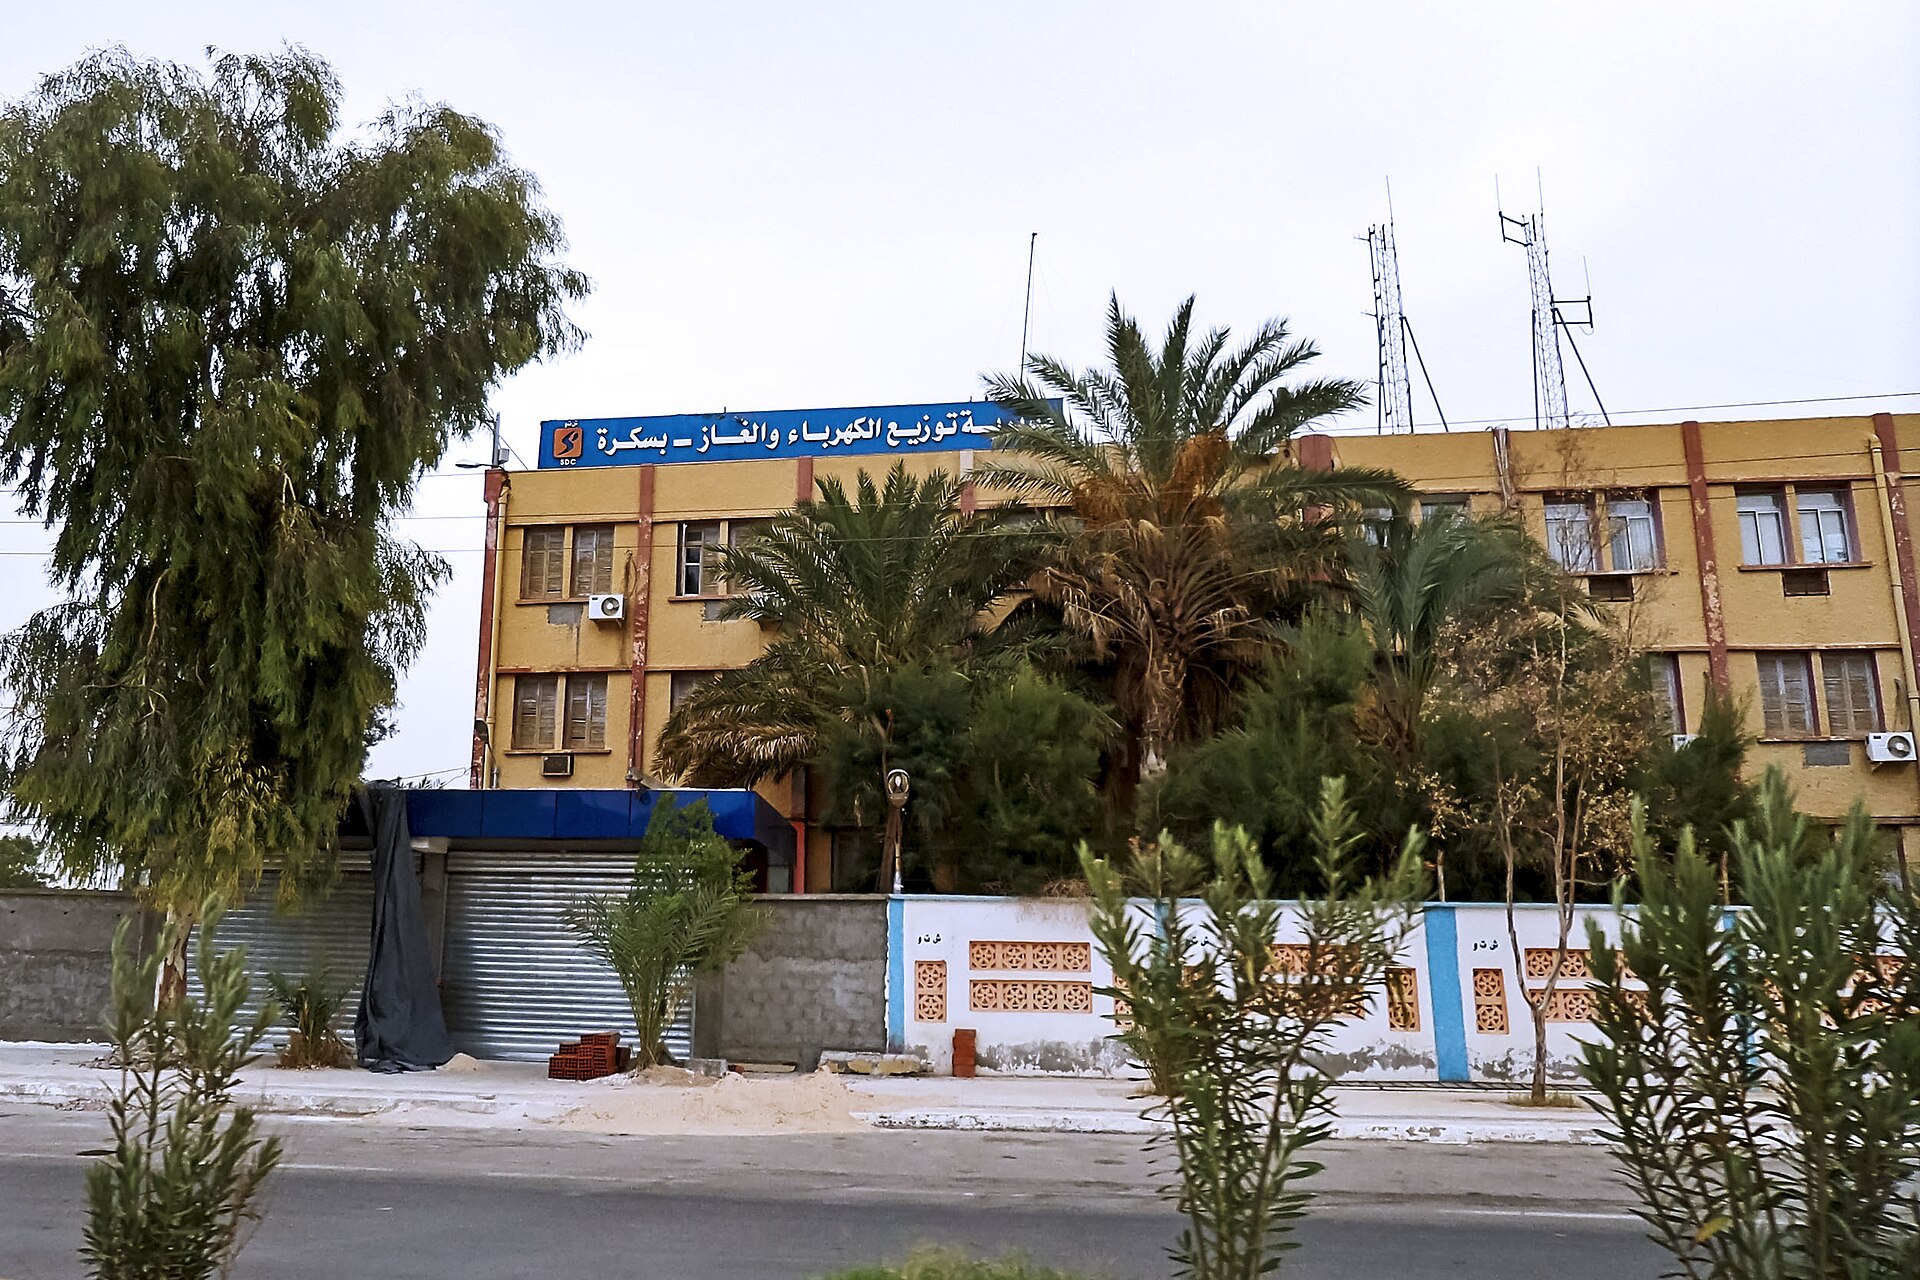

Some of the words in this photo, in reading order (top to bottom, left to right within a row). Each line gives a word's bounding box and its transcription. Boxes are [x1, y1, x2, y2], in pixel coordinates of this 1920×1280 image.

[597, 426, 668, 455] بسكرة
[696, 419, 780, 453] والغاز
[788, 416, 882, 449] الكهرباء
[887, 411, 958, 447] توزيع
[560, 458, 577, 466] SDC
